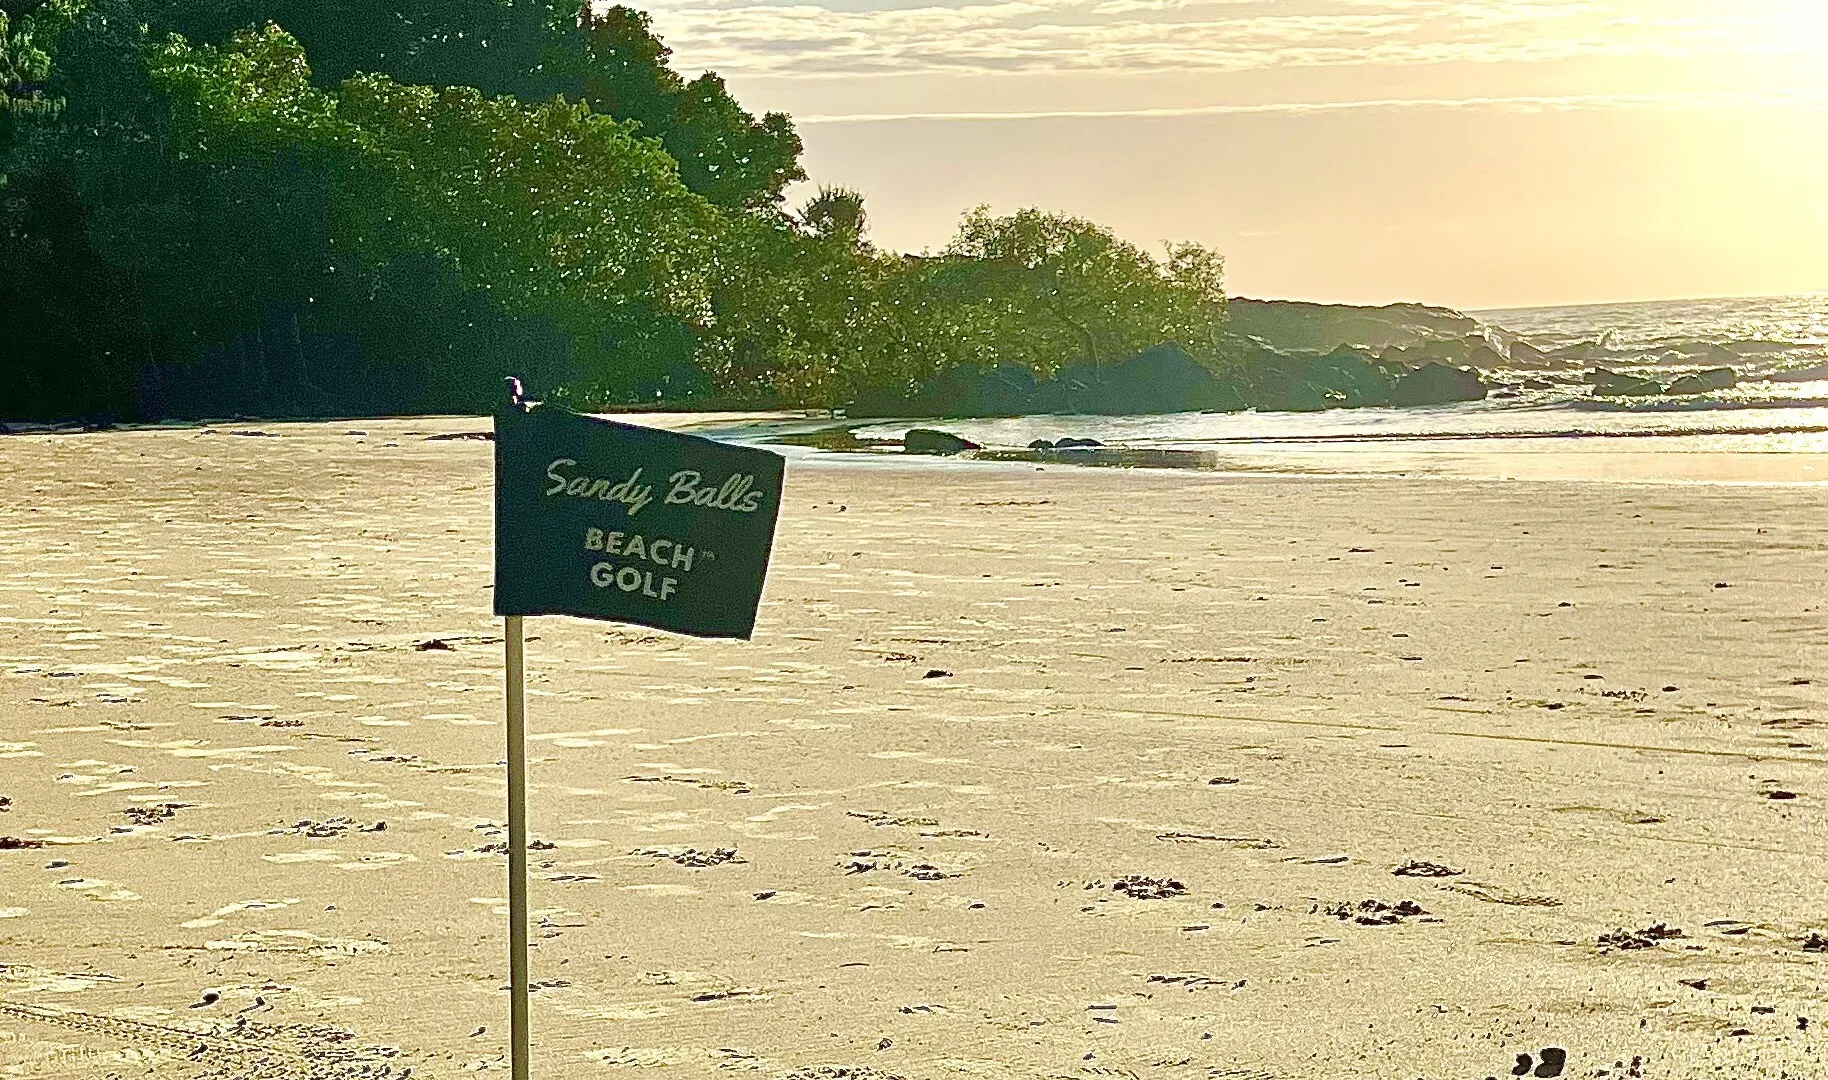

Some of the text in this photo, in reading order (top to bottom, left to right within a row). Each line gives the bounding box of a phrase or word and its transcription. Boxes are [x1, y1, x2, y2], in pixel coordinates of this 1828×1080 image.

[546, 458, 764, 516] Sandy Balls
[585, 527, 694, 572] BEACH
[590, 561, 678, 601] GOLF
